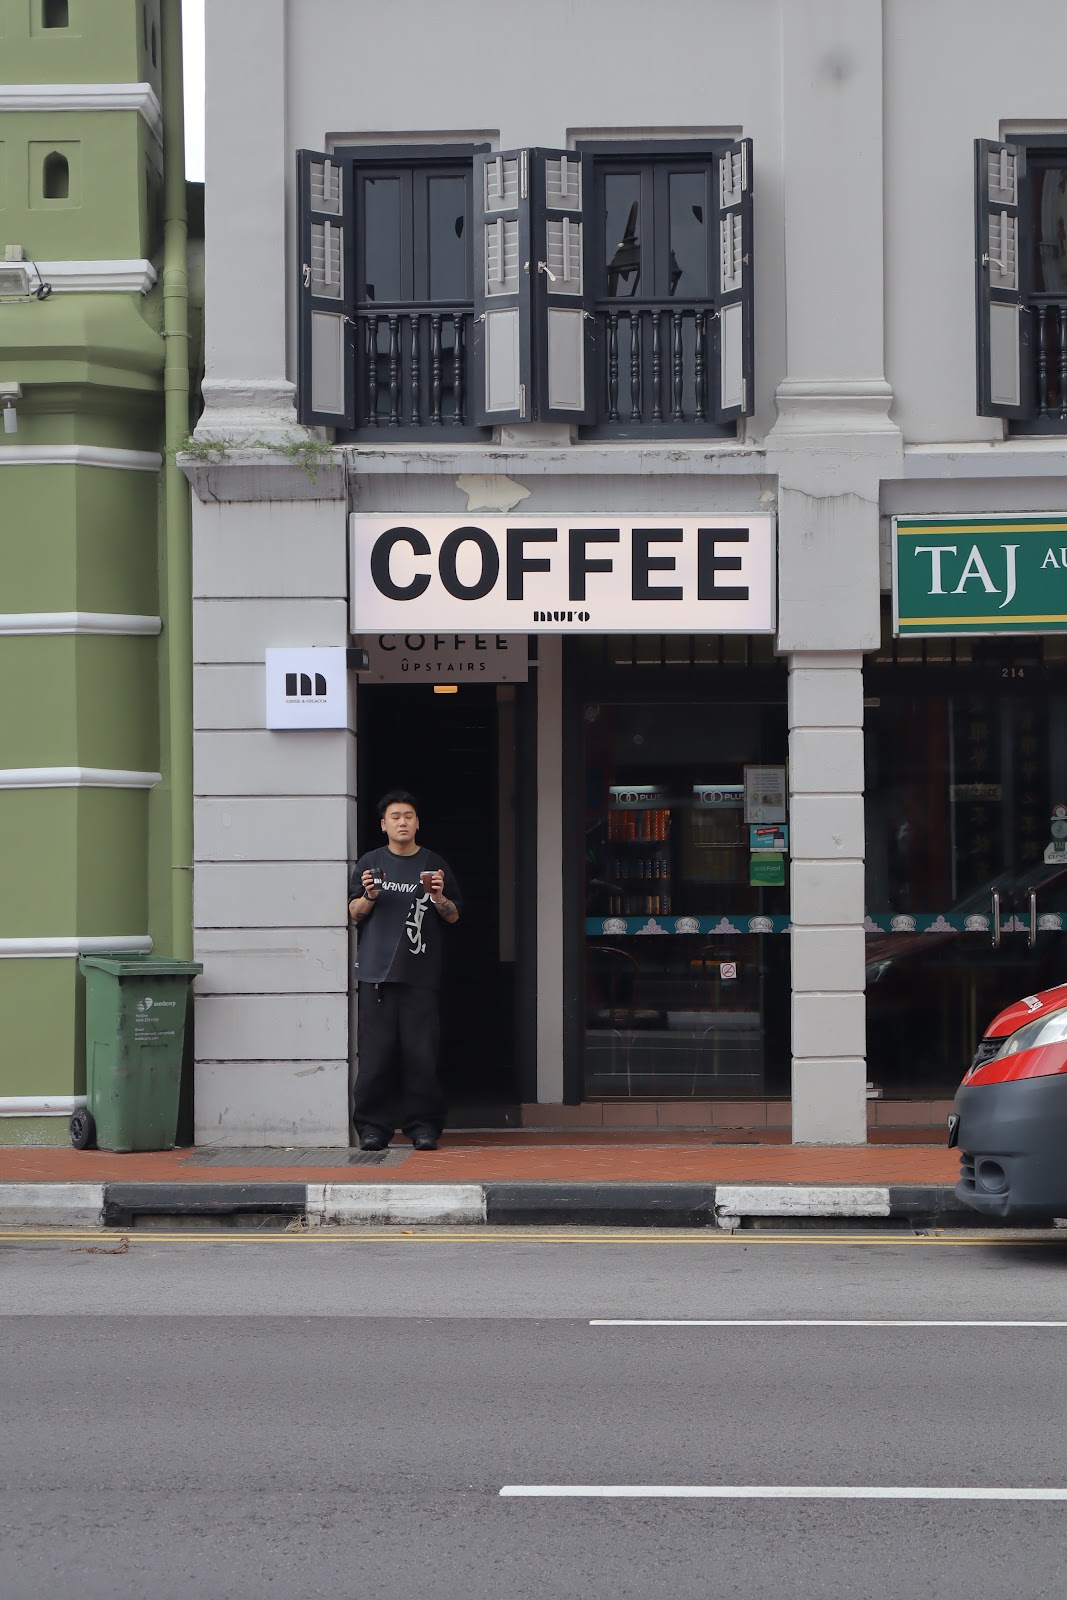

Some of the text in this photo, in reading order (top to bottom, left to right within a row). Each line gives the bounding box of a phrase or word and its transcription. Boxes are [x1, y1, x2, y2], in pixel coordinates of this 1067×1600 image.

[370, 526, 749, 601] COFFEE
[914, 544, 1021, 608] TAJ
[533, 610, 591, 622] muro
[378, 634, 508, 652] COFFEE
[1002, 668, 1025, 678] 214
